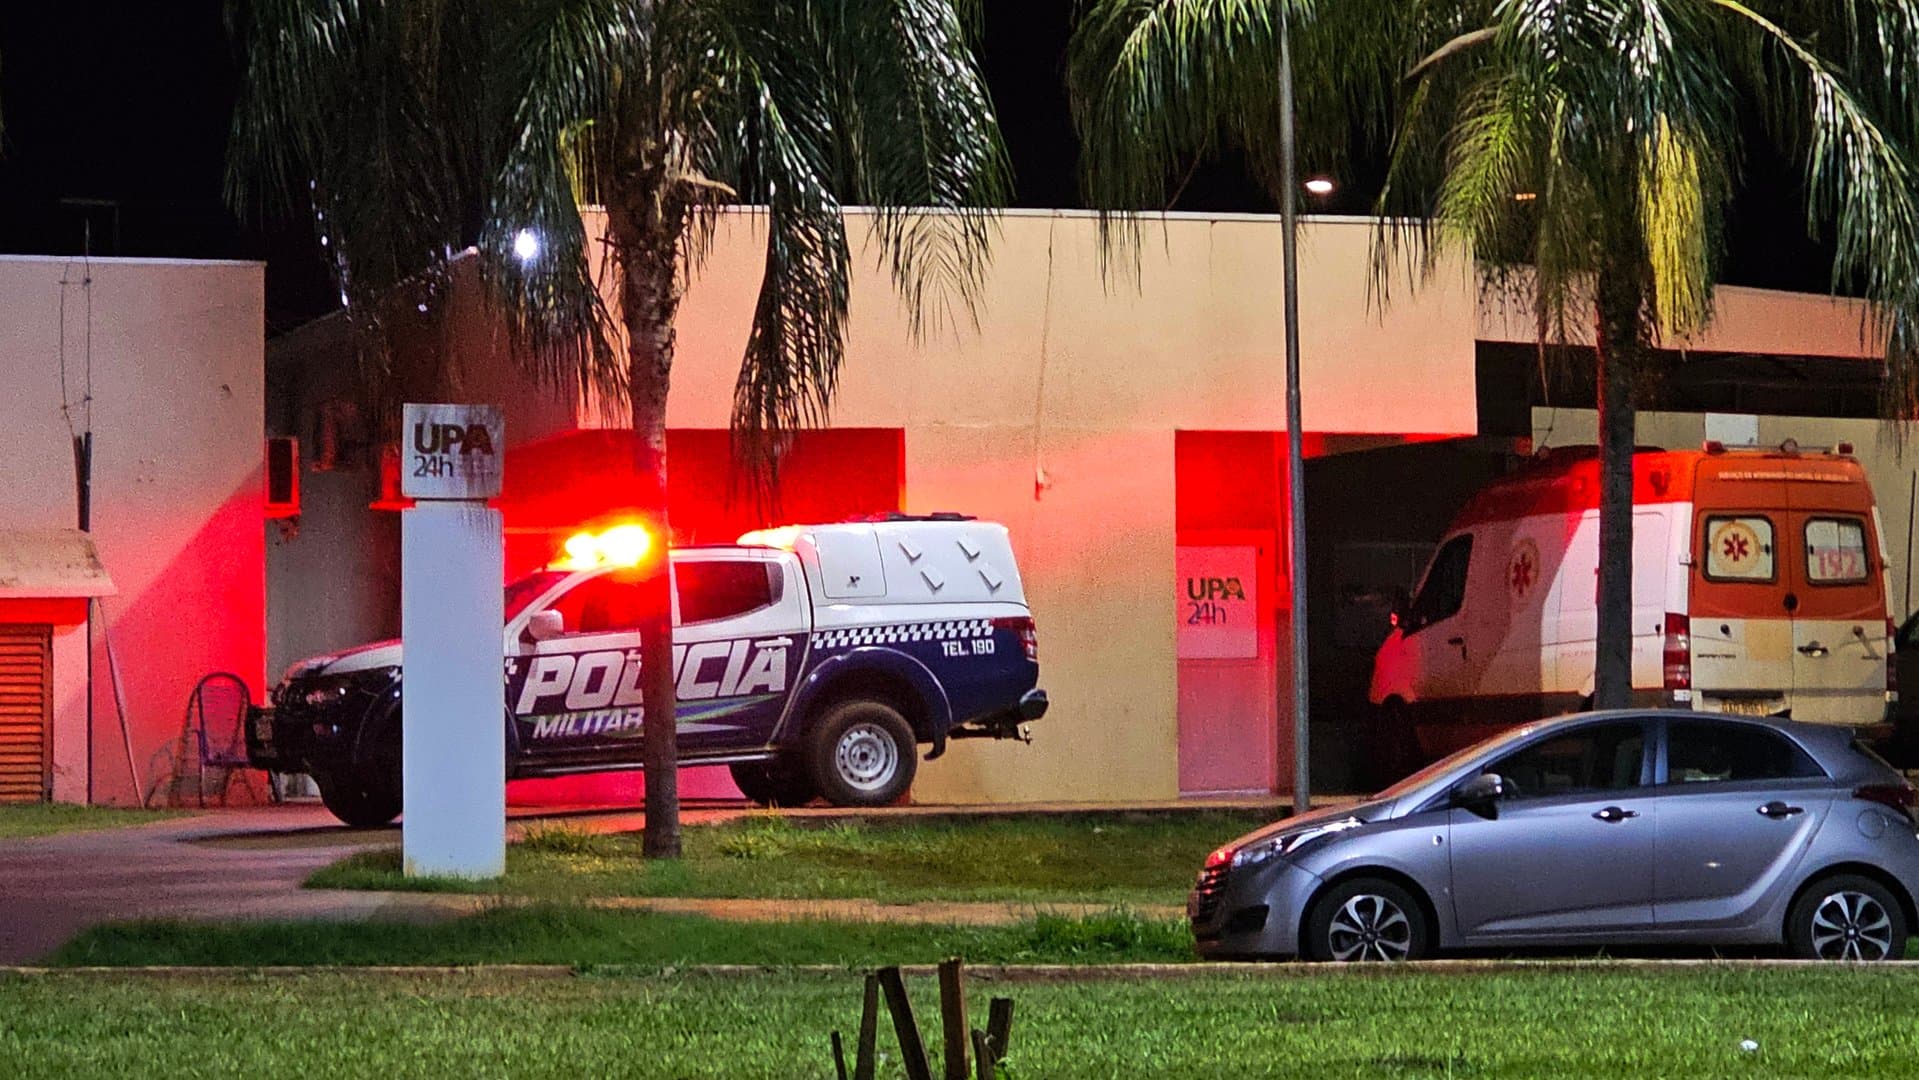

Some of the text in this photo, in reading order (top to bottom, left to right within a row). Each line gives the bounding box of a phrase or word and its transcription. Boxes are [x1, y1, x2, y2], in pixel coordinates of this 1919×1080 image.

[414, 423, 494, 454] UPA
[414, 455, 453, 477] 24h
[1187, 577, 1245, 600] UPA
[1187, 602, 1226, 624] 24h
[941, 639, 995, 656] TEL. 190
[515, 639, 785, 715] POLCIA
